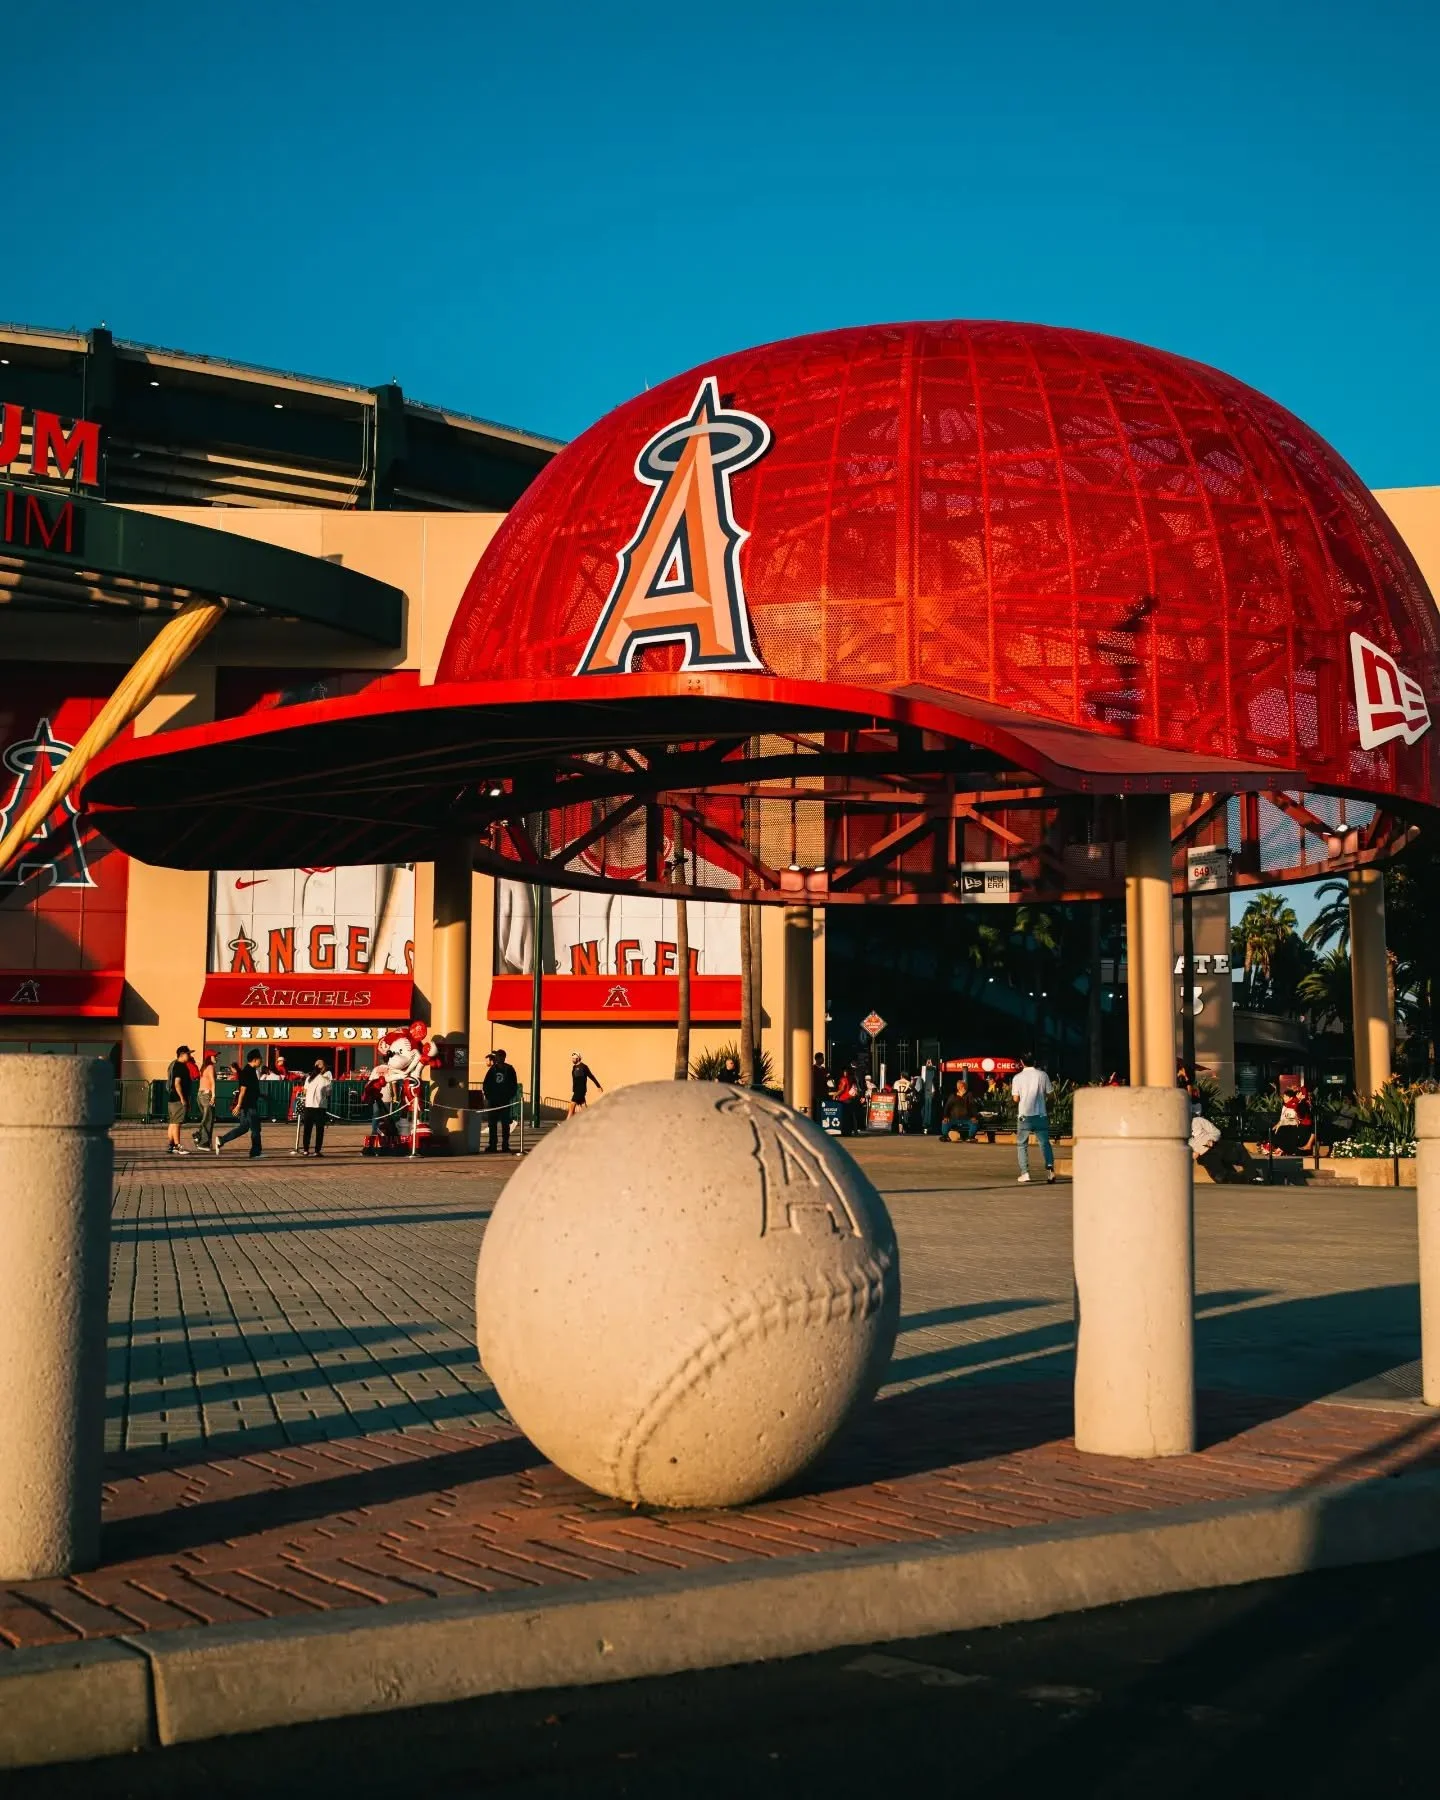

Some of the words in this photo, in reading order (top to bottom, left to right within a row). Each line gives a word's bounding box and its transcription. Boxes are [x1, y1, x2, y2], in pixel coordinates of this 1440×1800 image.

[572, 376, 771, 676] A
[1173, 954, 1230, 974] ATE
[241, 982, 371, 1006] ANGELS
[225, 1026, 289, 1039] TEAM
